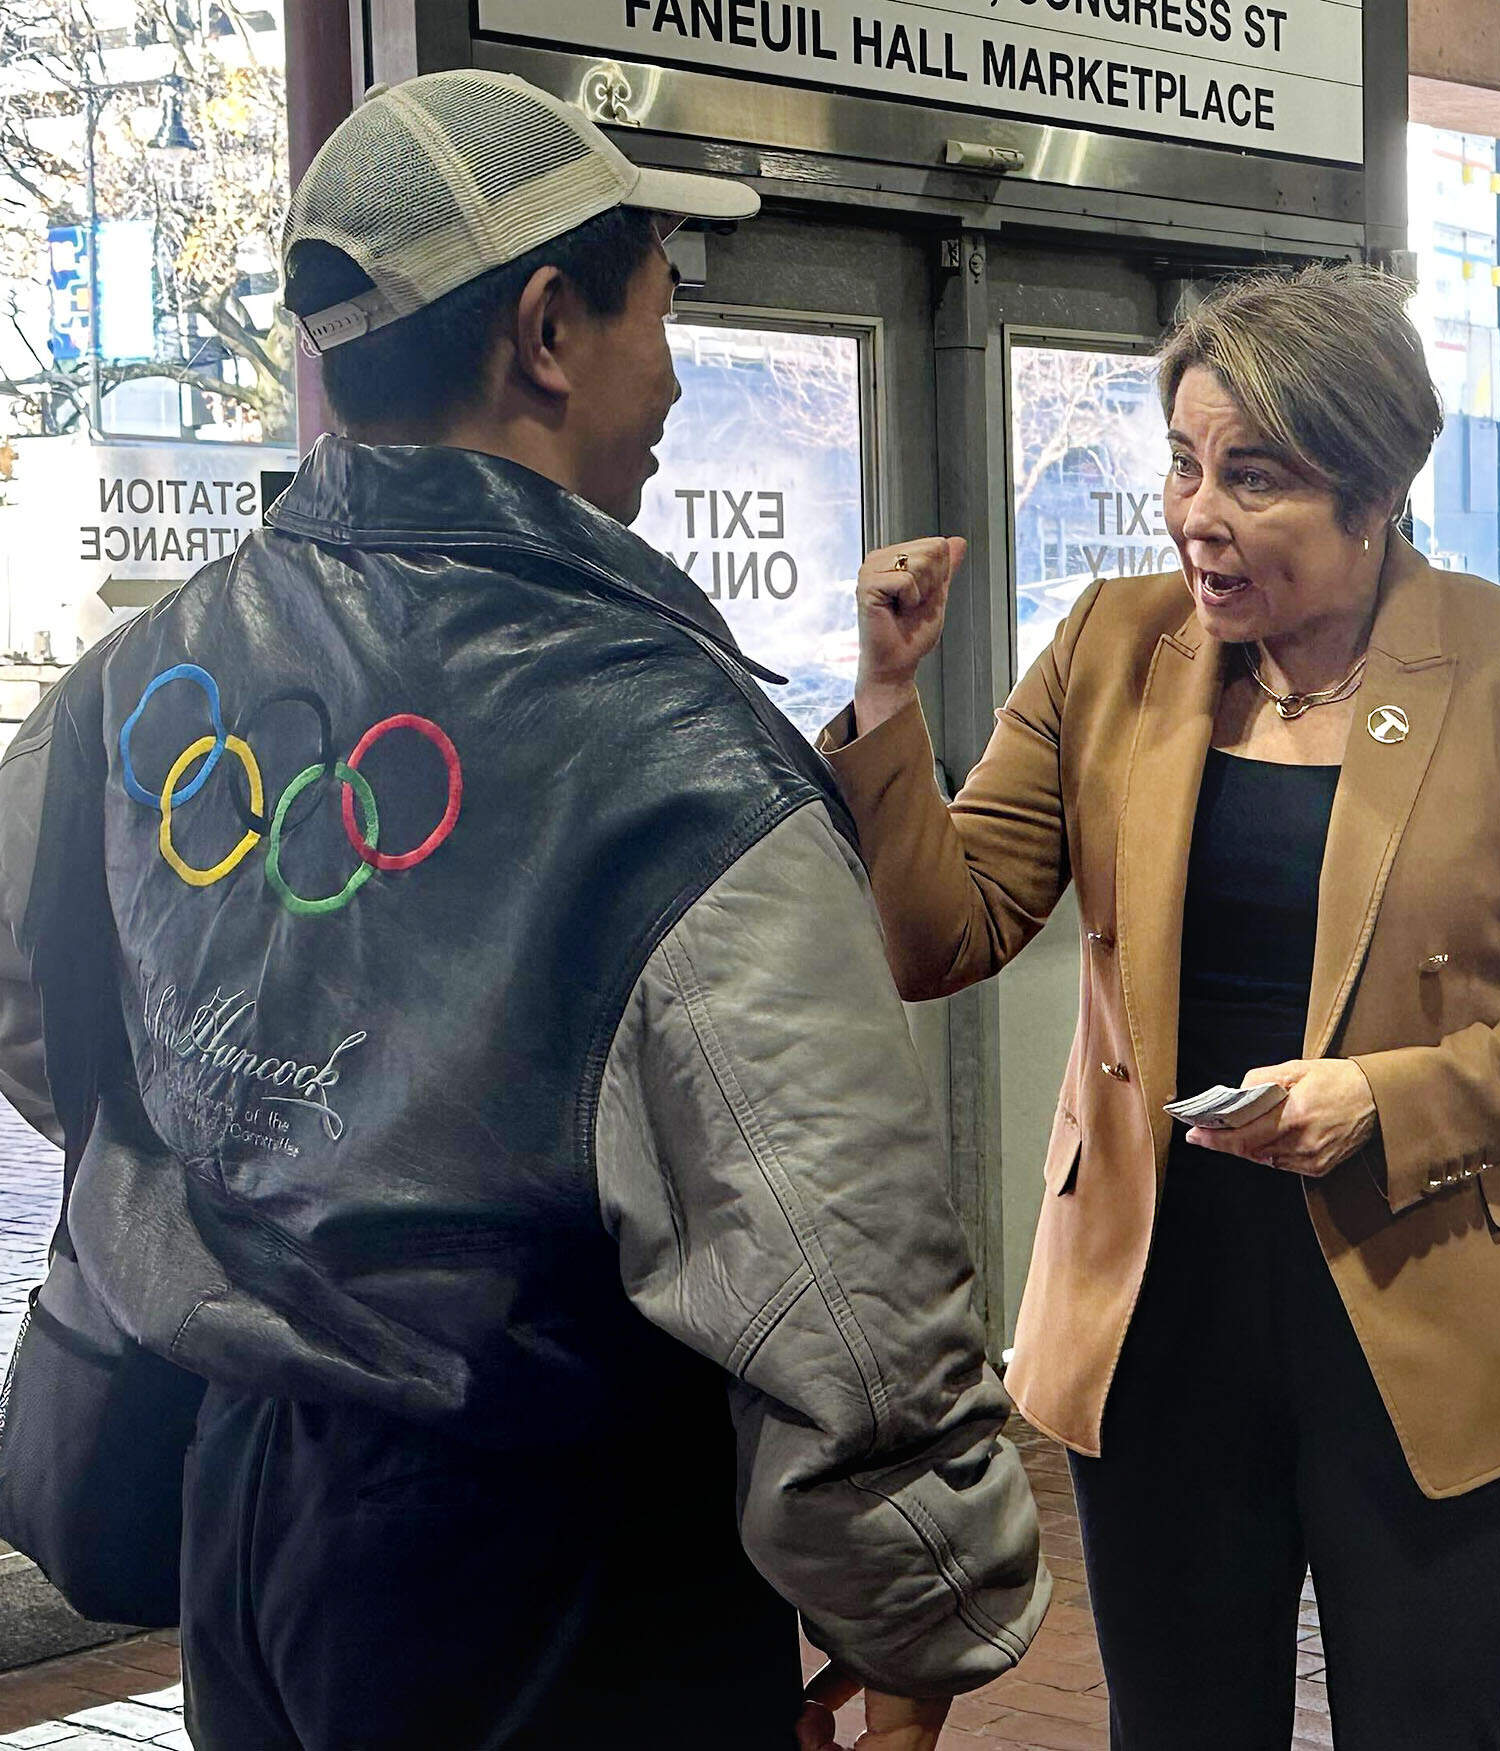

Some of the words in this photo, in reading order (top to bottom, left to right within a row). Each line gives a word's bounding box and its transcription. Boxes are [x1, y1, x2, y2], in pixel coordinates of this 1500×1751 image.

[625, 0, 838, 60] FANEUIL
[853, 17, 968, 82] HALL
[982, 40, 1276, 131] MARKETPLACE
[1244, 4, 1288, 51] ST
